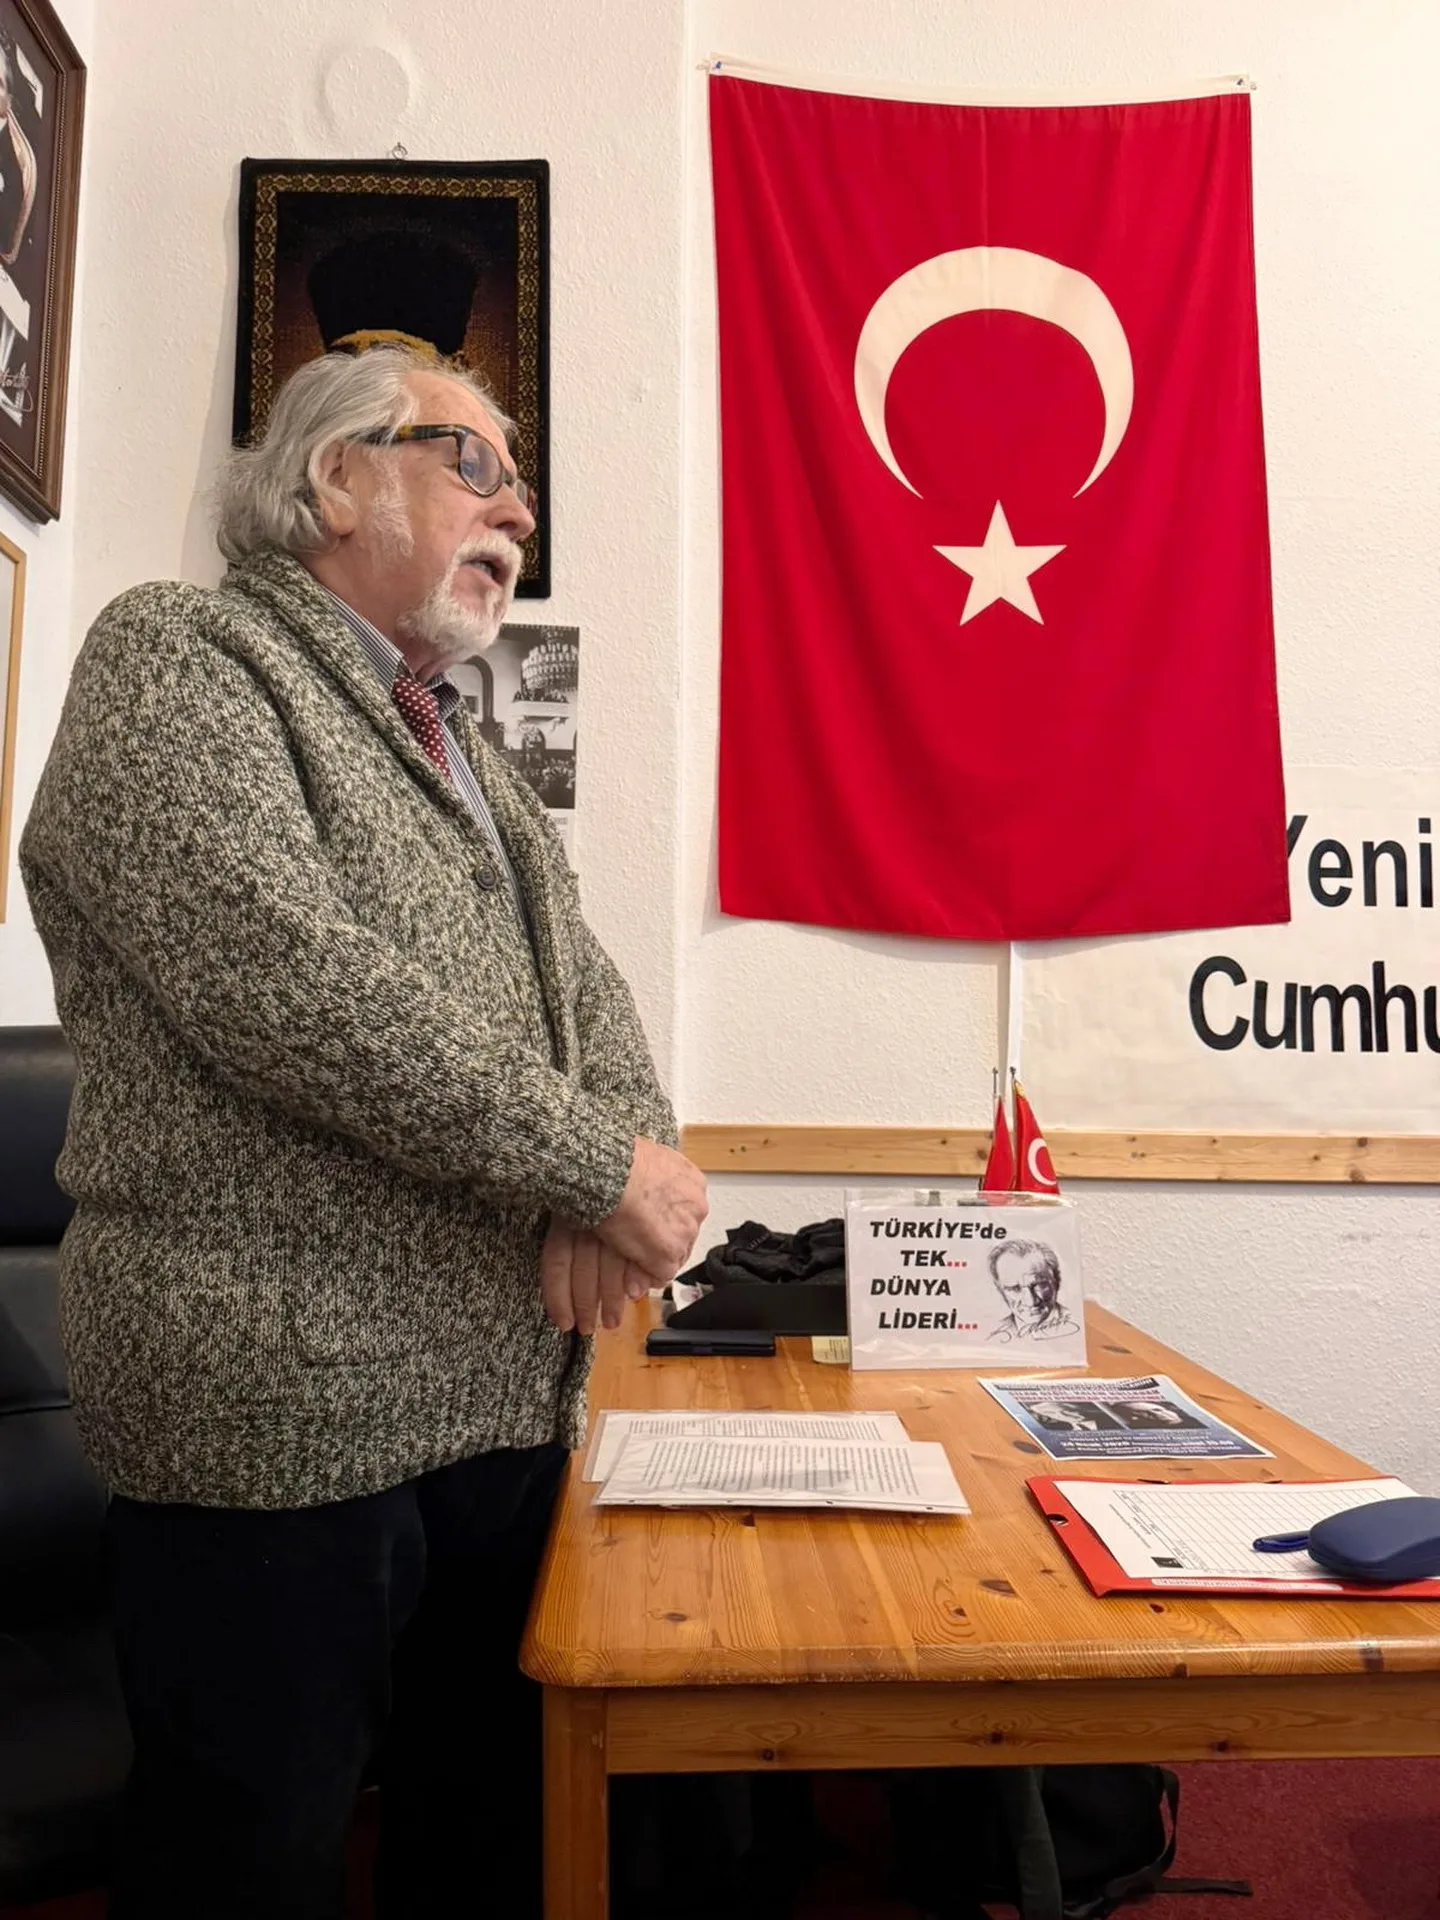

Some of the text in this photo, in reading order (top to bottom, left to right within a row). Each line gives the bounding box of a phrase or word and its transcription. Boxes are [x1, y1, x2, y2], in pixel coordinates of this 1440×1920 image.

[869, 1218, 1008, 1240] TÜRKİYE'de
[900, 1250, 968, 1267] TEK...
[870, 1275, 952, 1297] DÜNYA
[878, 1308, 979, 1330] LİDERİ...
